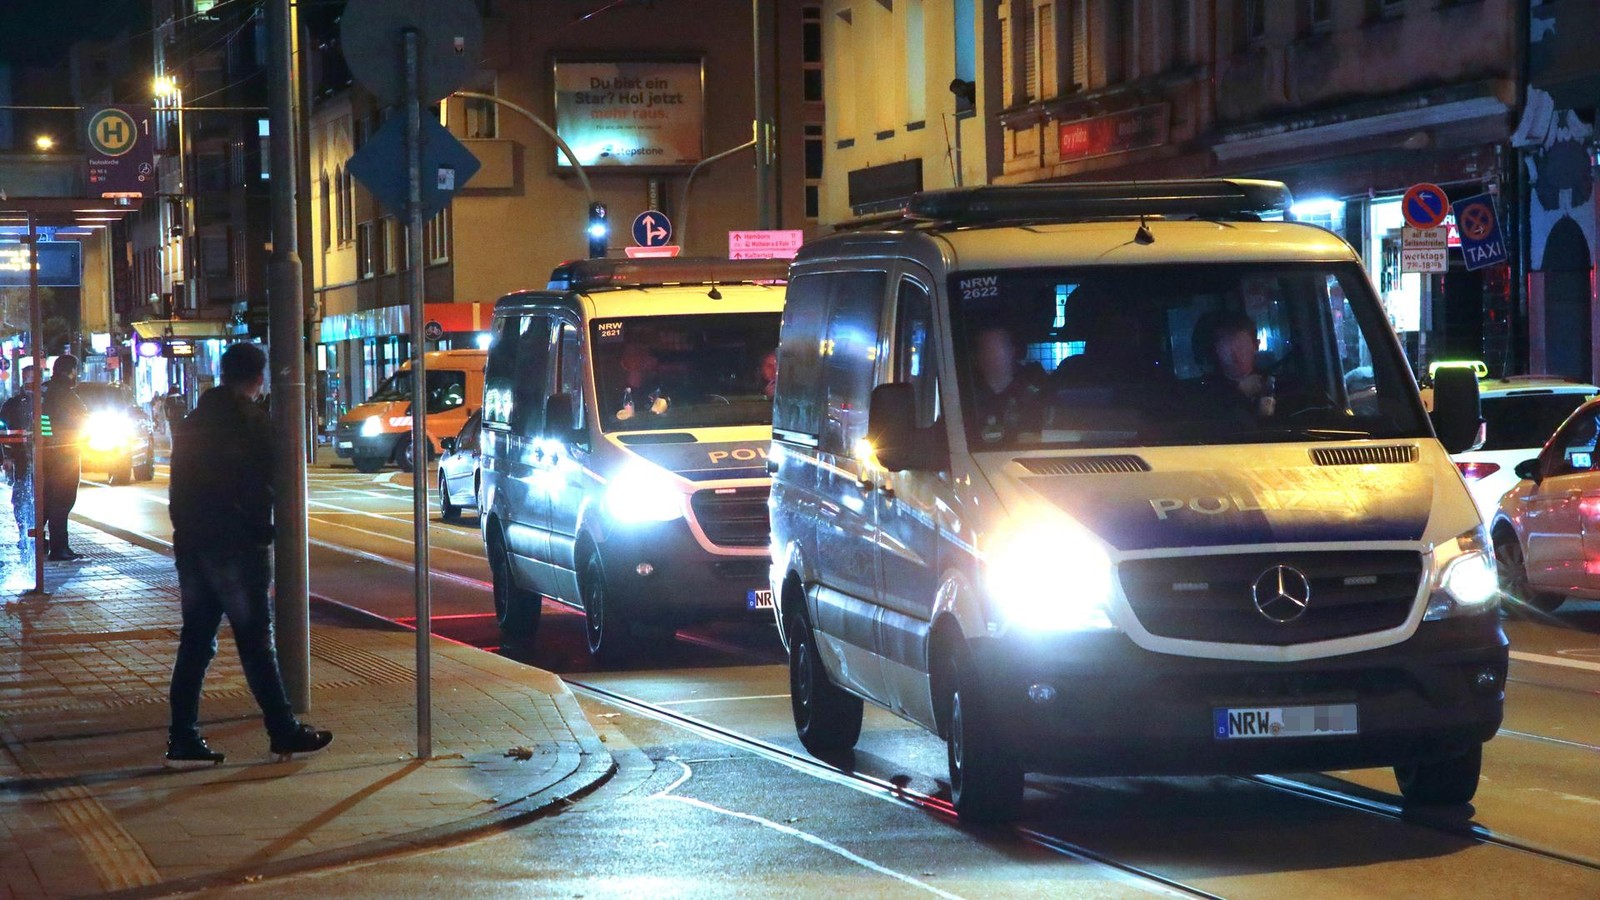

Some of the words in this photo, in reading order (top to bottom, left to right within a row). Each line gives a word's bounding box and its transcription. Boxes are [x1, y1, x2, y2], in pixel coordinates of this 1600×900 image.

[590, 77, 610, 90] Du
[614, 76, 641, 90] bist
[645, 77, 668, 90] ein
[575, 92, 615, 105] Star?
[619, 92, 643, 104] Hol
[646, 92, 683, 107] jetzt
[591, 108, 627, 119] mehr
[633, 110, 669, 119] raus.
[103, 122, 123, 143] H
[142, 119, 148, 135] 1
[1404, 251, 1445, 261] werktags
[1467, 241, 1502, 262] TAXI
[960, 276, 997, 289] NRW
[963, 286, 998, 300] 2622
[598, 322, 623, 331] NRW
[1228, 711, 1270, 735] NRW
